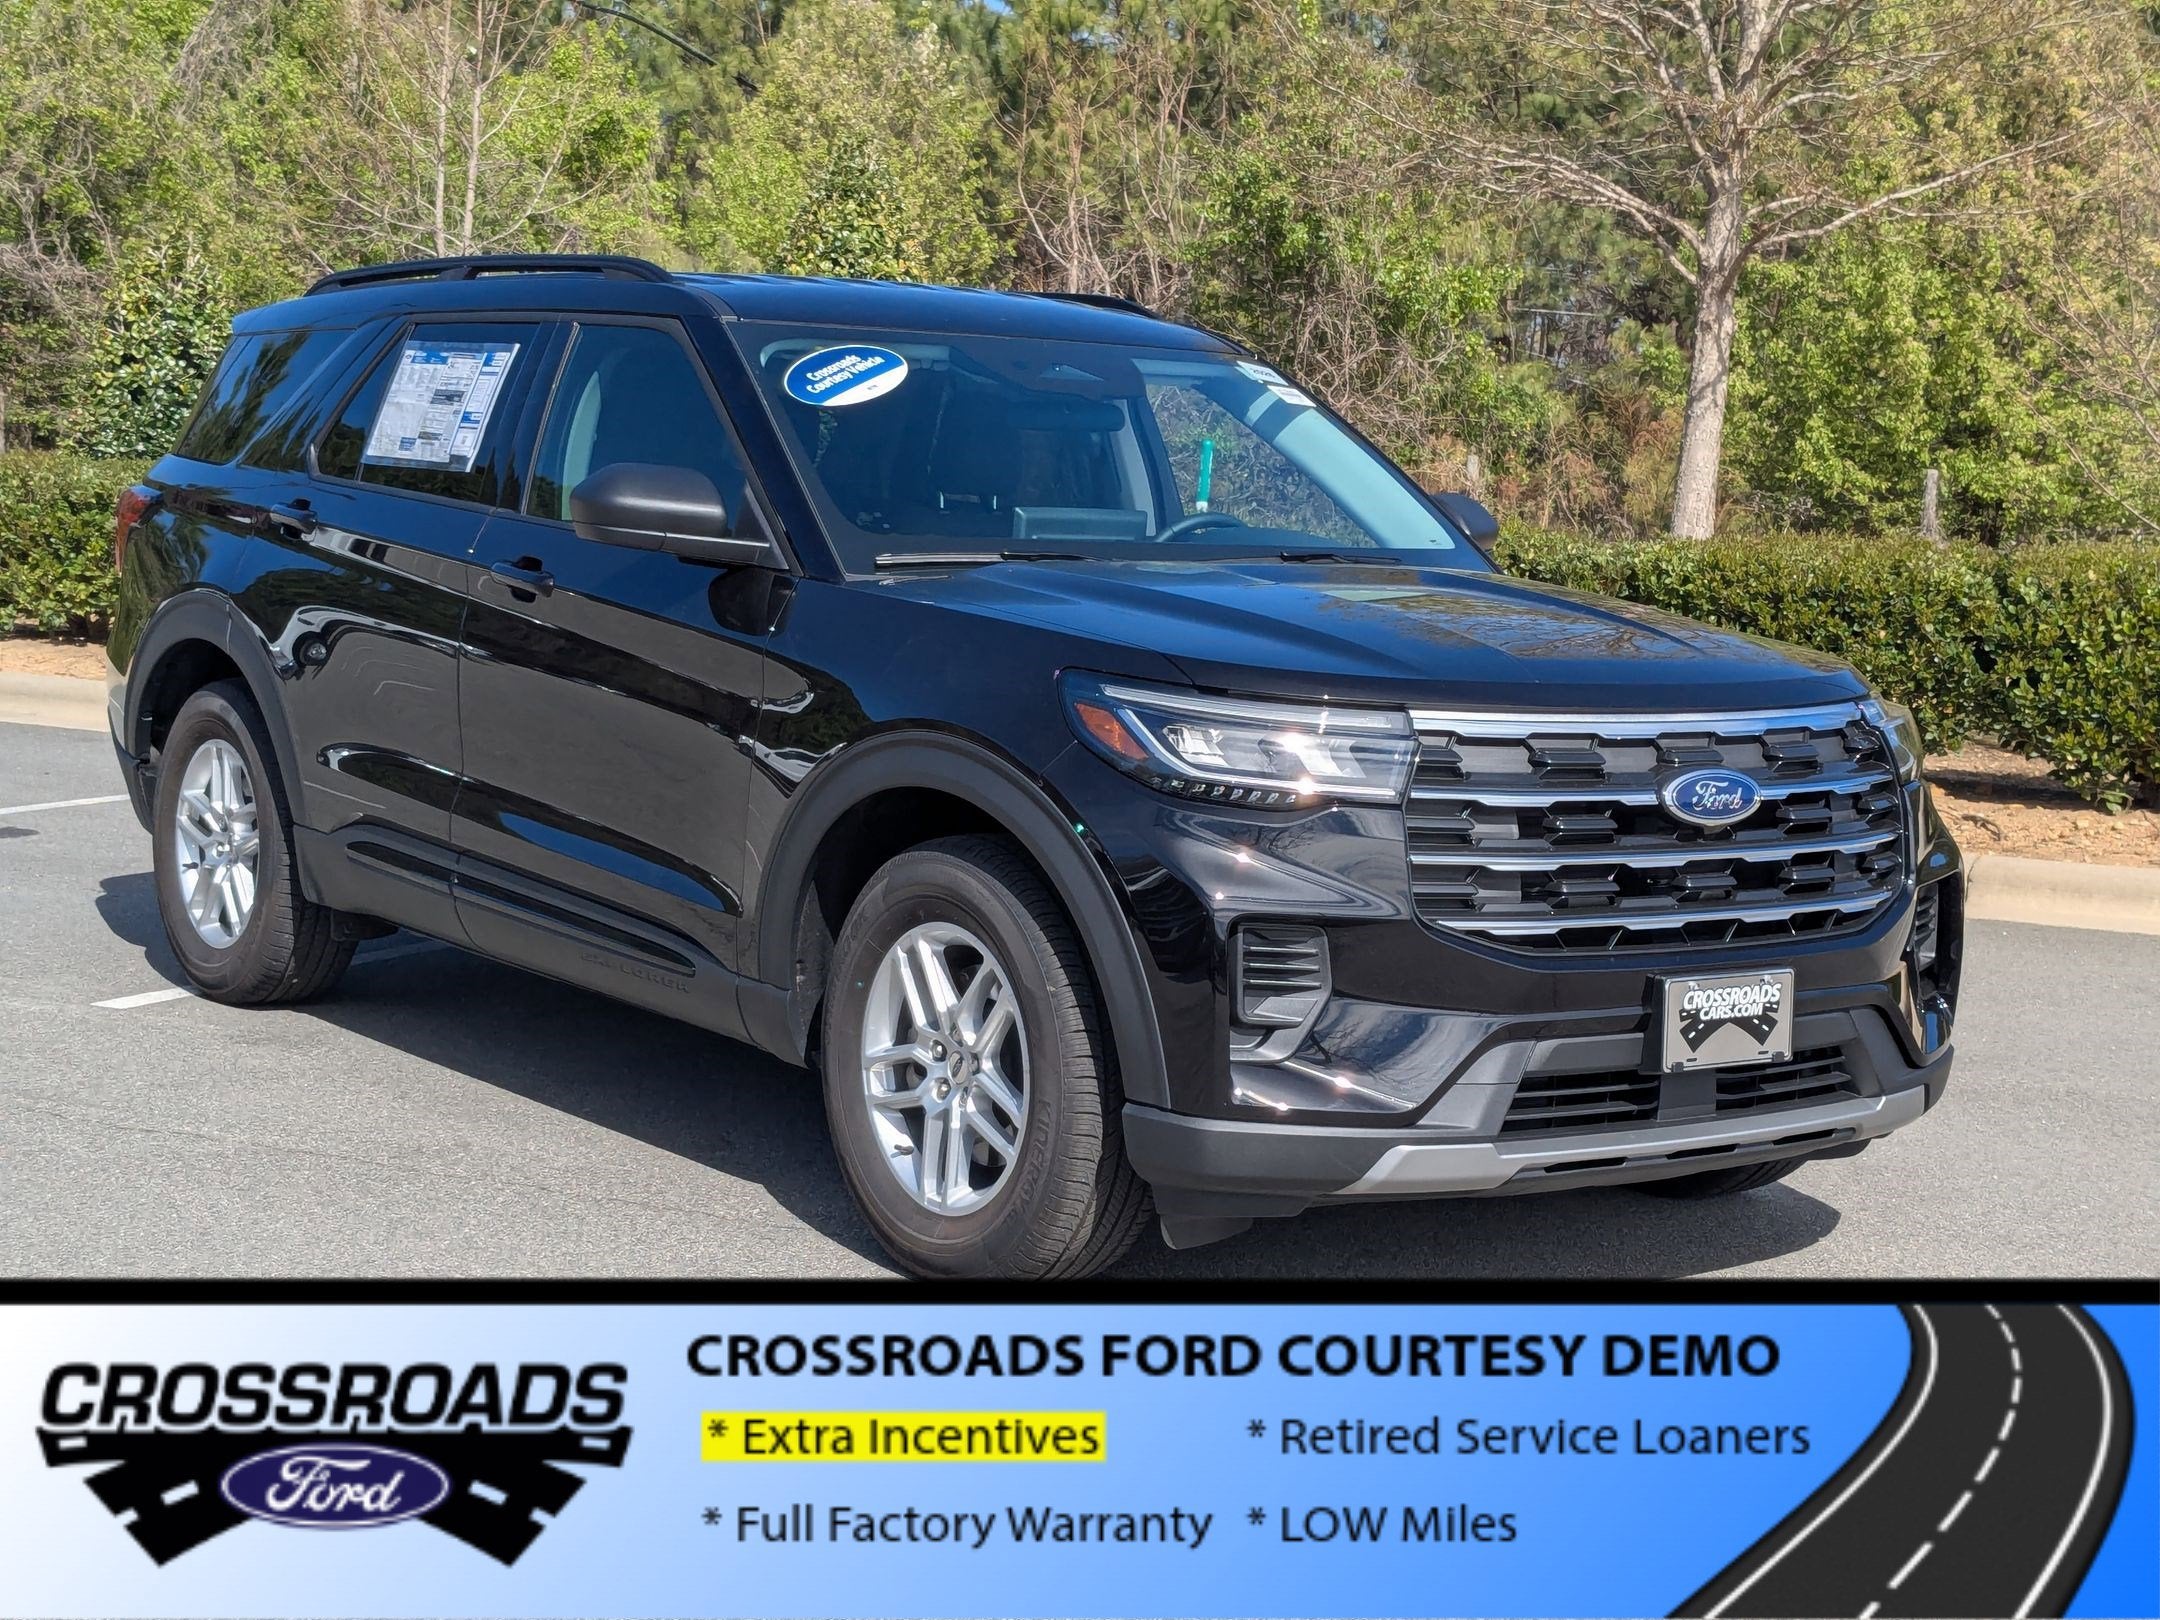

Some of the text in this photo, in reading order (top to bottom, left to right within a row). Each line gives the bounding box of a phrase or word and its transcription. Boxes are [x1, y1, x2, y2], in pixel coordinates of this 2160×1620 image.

[806, 355, 861, 381] Crossroads
[806, 356, 885, 393] Courtesy Vehicle
[1692, 780, 1743, 810] Ford
[1683, 983, 1782, 1010] CROSSROADS
[1699, 1003, 1764, 1020] CARS.COM
